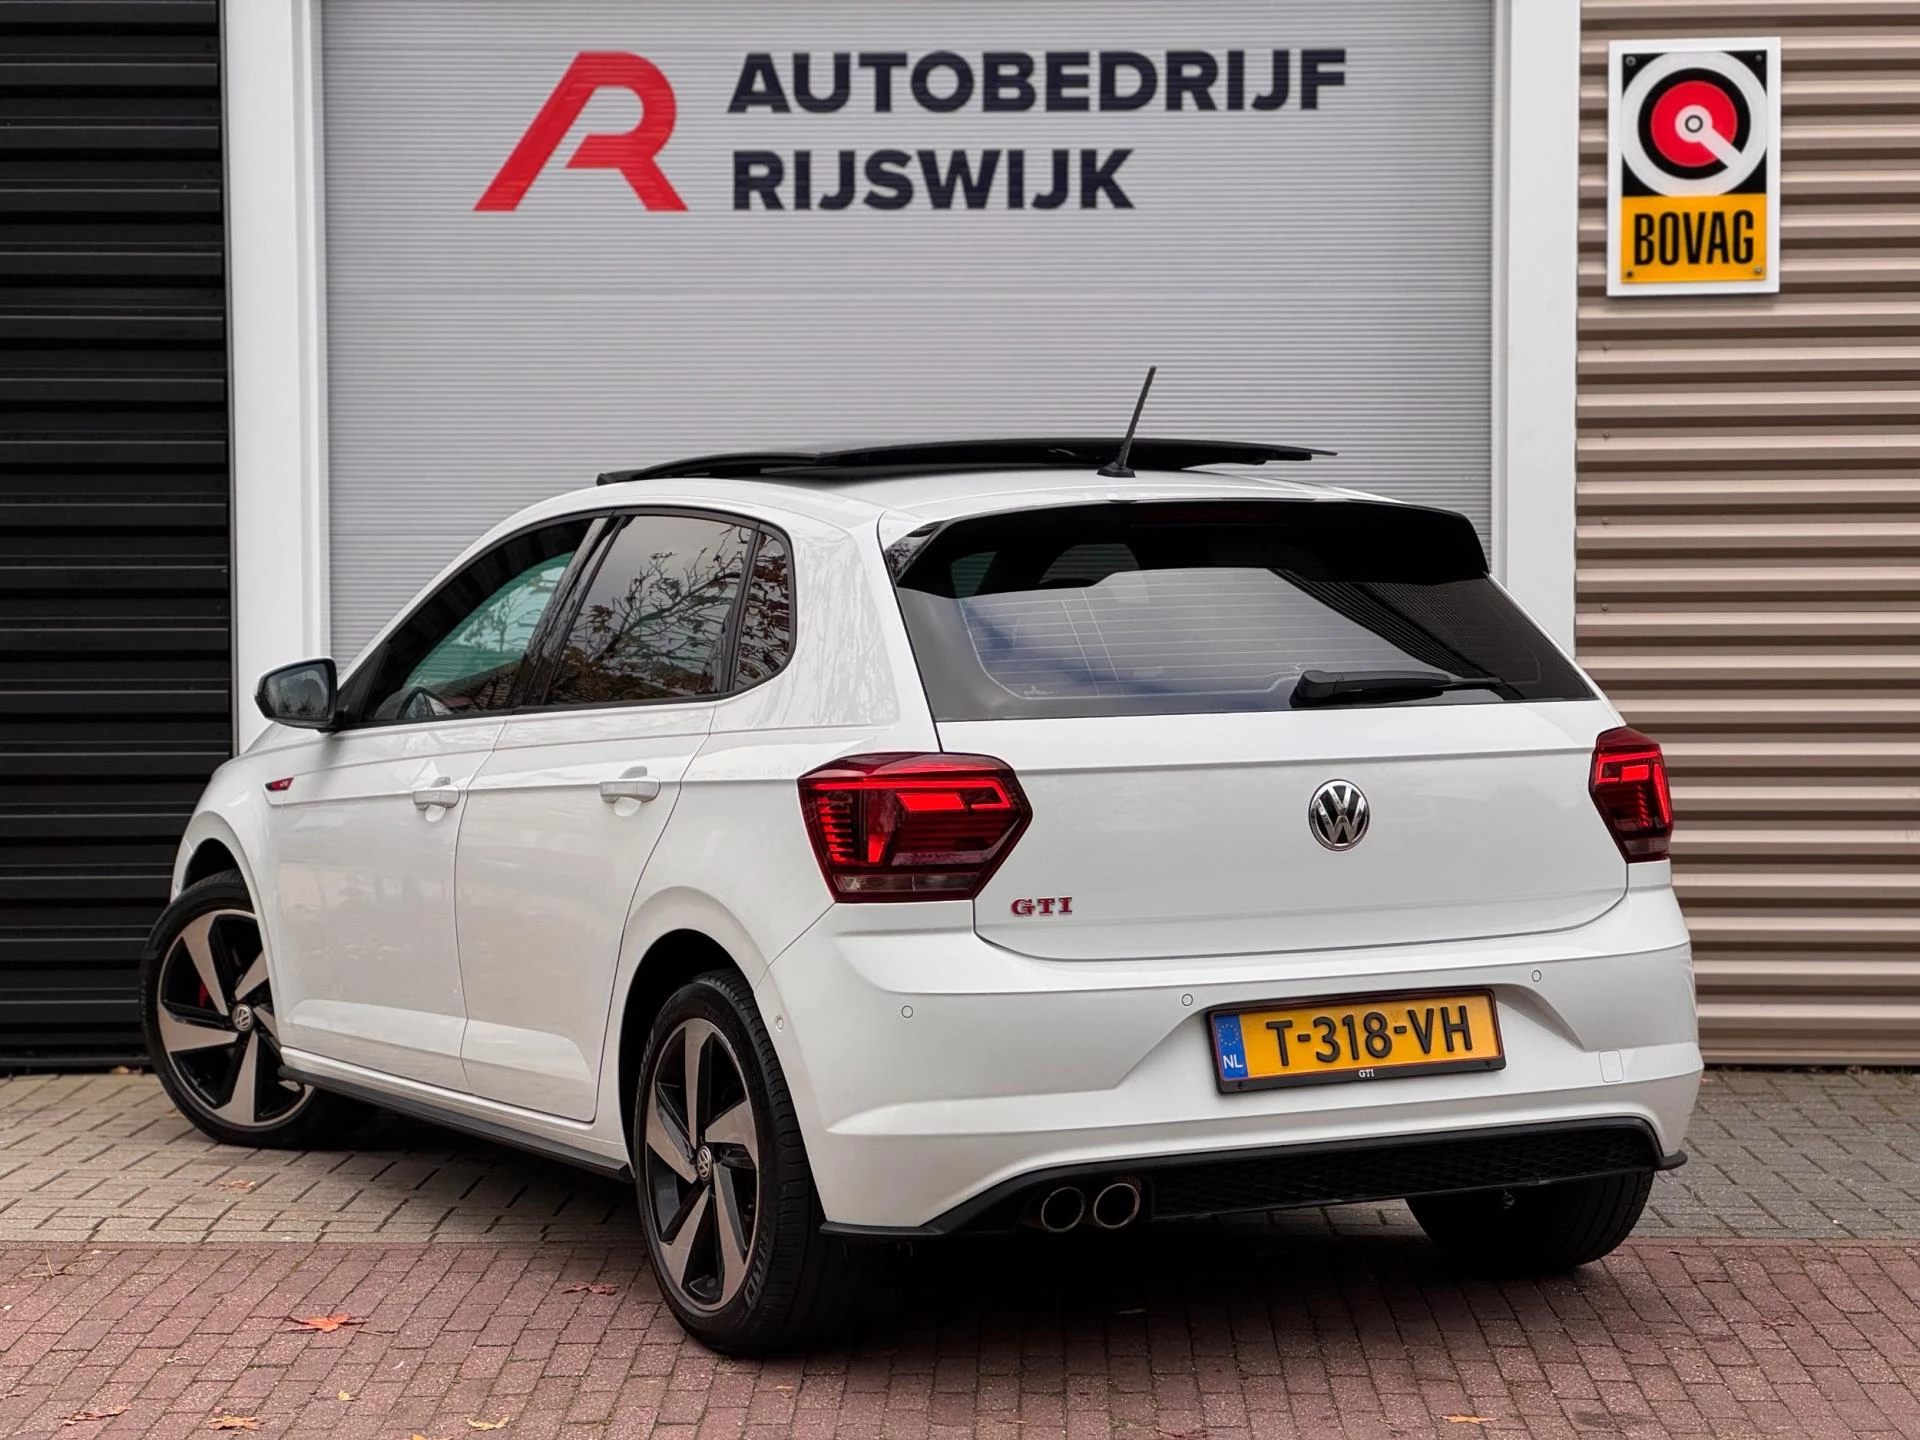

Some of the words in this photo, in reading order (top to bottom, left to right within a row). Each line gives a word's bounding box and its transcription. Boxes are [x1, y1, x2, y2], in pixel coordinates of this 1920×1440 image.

[727, 48, 1347, 114] AUTOBEDRIJF
[732, 149, 1135, 211] RIJSWIJK
[1634, 210, 1754, 266] BOVAG
[1011, 896, 1073, 917] GTI
[1223, 1054, 1243, 1070] NL
[1266, 1005, 1473, 1067] T-318-VH
[1358, 1069, 1375, 1079] GTI
